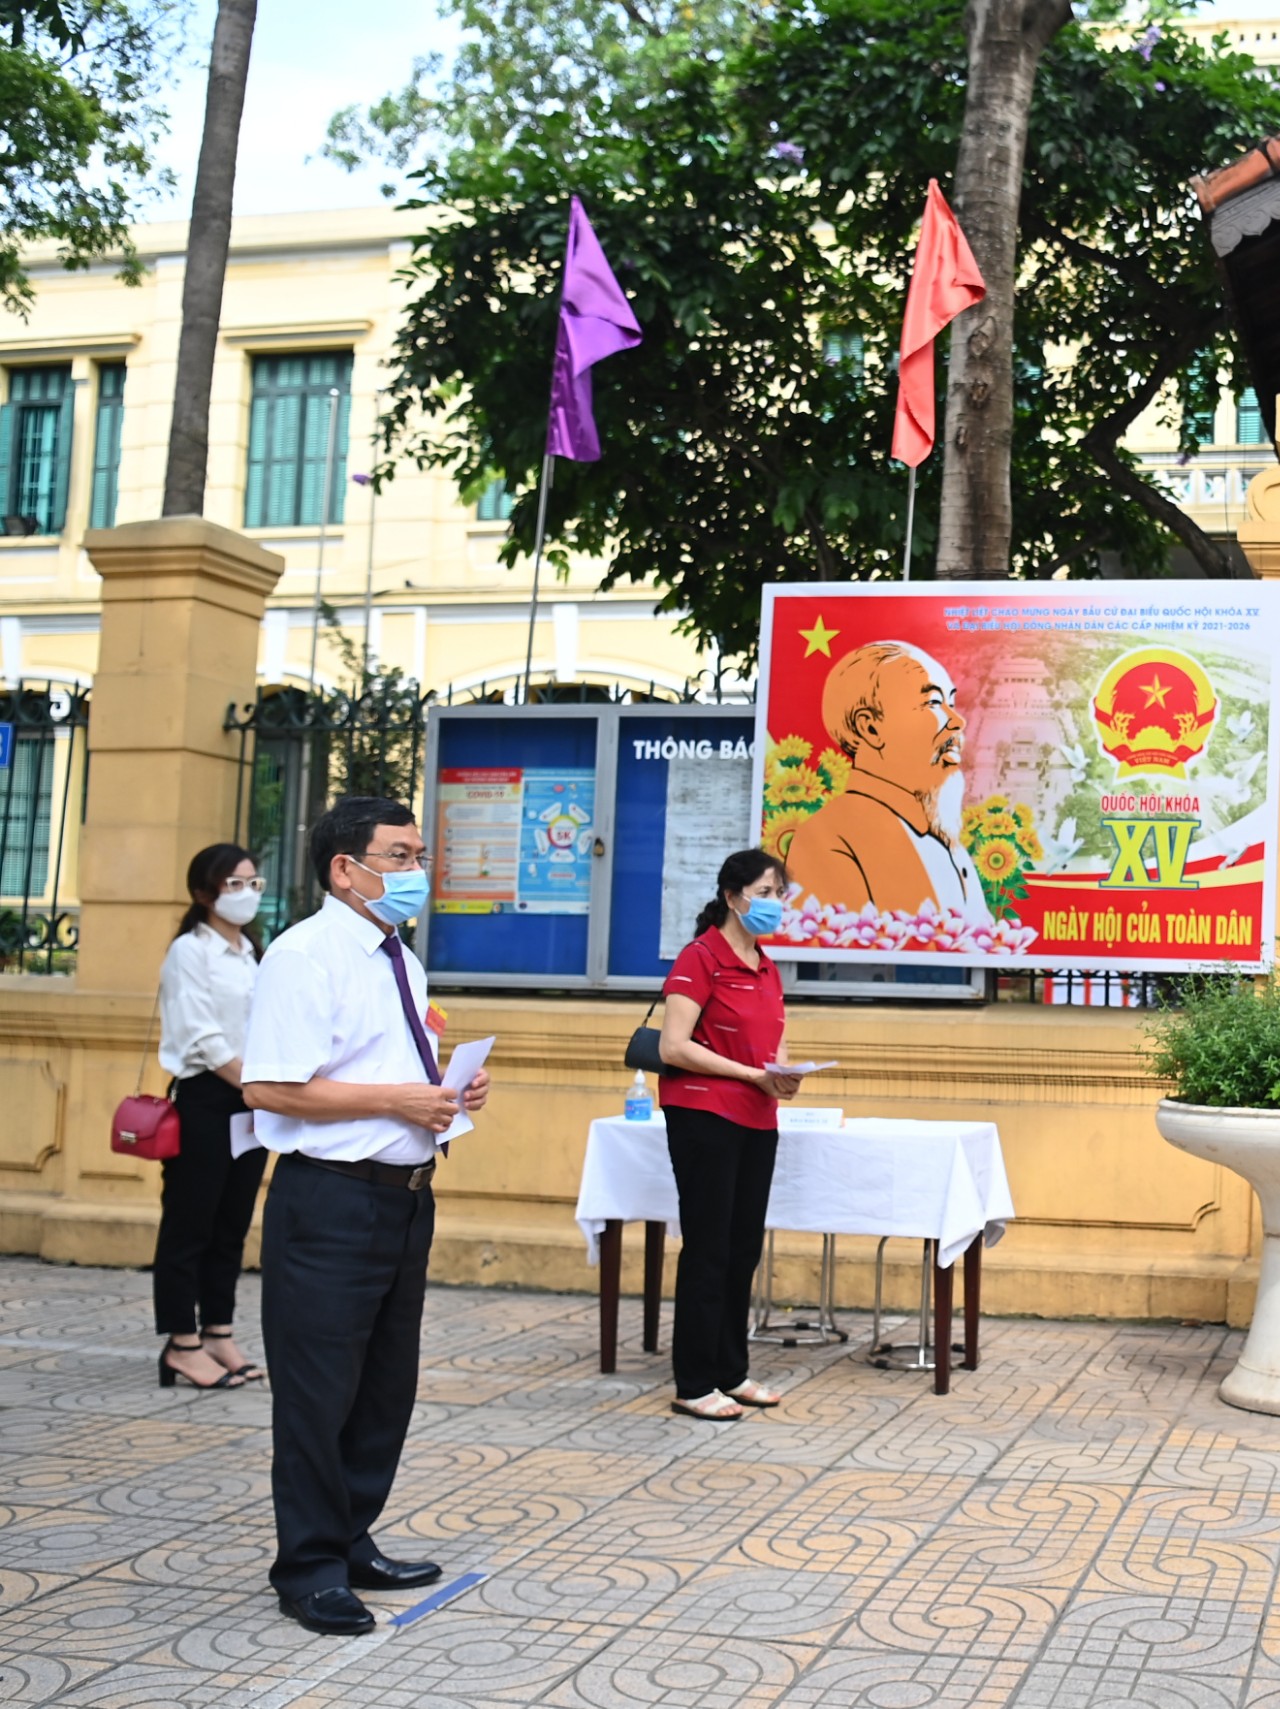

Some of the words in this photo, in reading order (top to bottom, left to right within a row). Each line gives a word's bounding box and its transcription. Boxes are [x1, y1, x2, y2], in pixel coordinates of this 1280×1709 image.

[1162, 606, 1192, 617] QUỐC
[1195, 606, 1212, 618] HỘI
[1202, 622, 1250, 630] 2021-2026
[633, 736, 713, 759] THÔNG
[1102, 791, 1135, 812] QUỐC
[1140, 794, 1161, 816] HỘI
[1166, 794, 1200, 812] KHÓA
[1098, 818, 1201, 889] XV
[1043, 906, 1089, 941] NGÀY
[1093, 906, 1122, 948] HỘI
[1127, 901, 1161, 943] CỦA
[1166, 908, 1211, 944] TOÀN
[1216, 909, 1252, 945] DÂN
